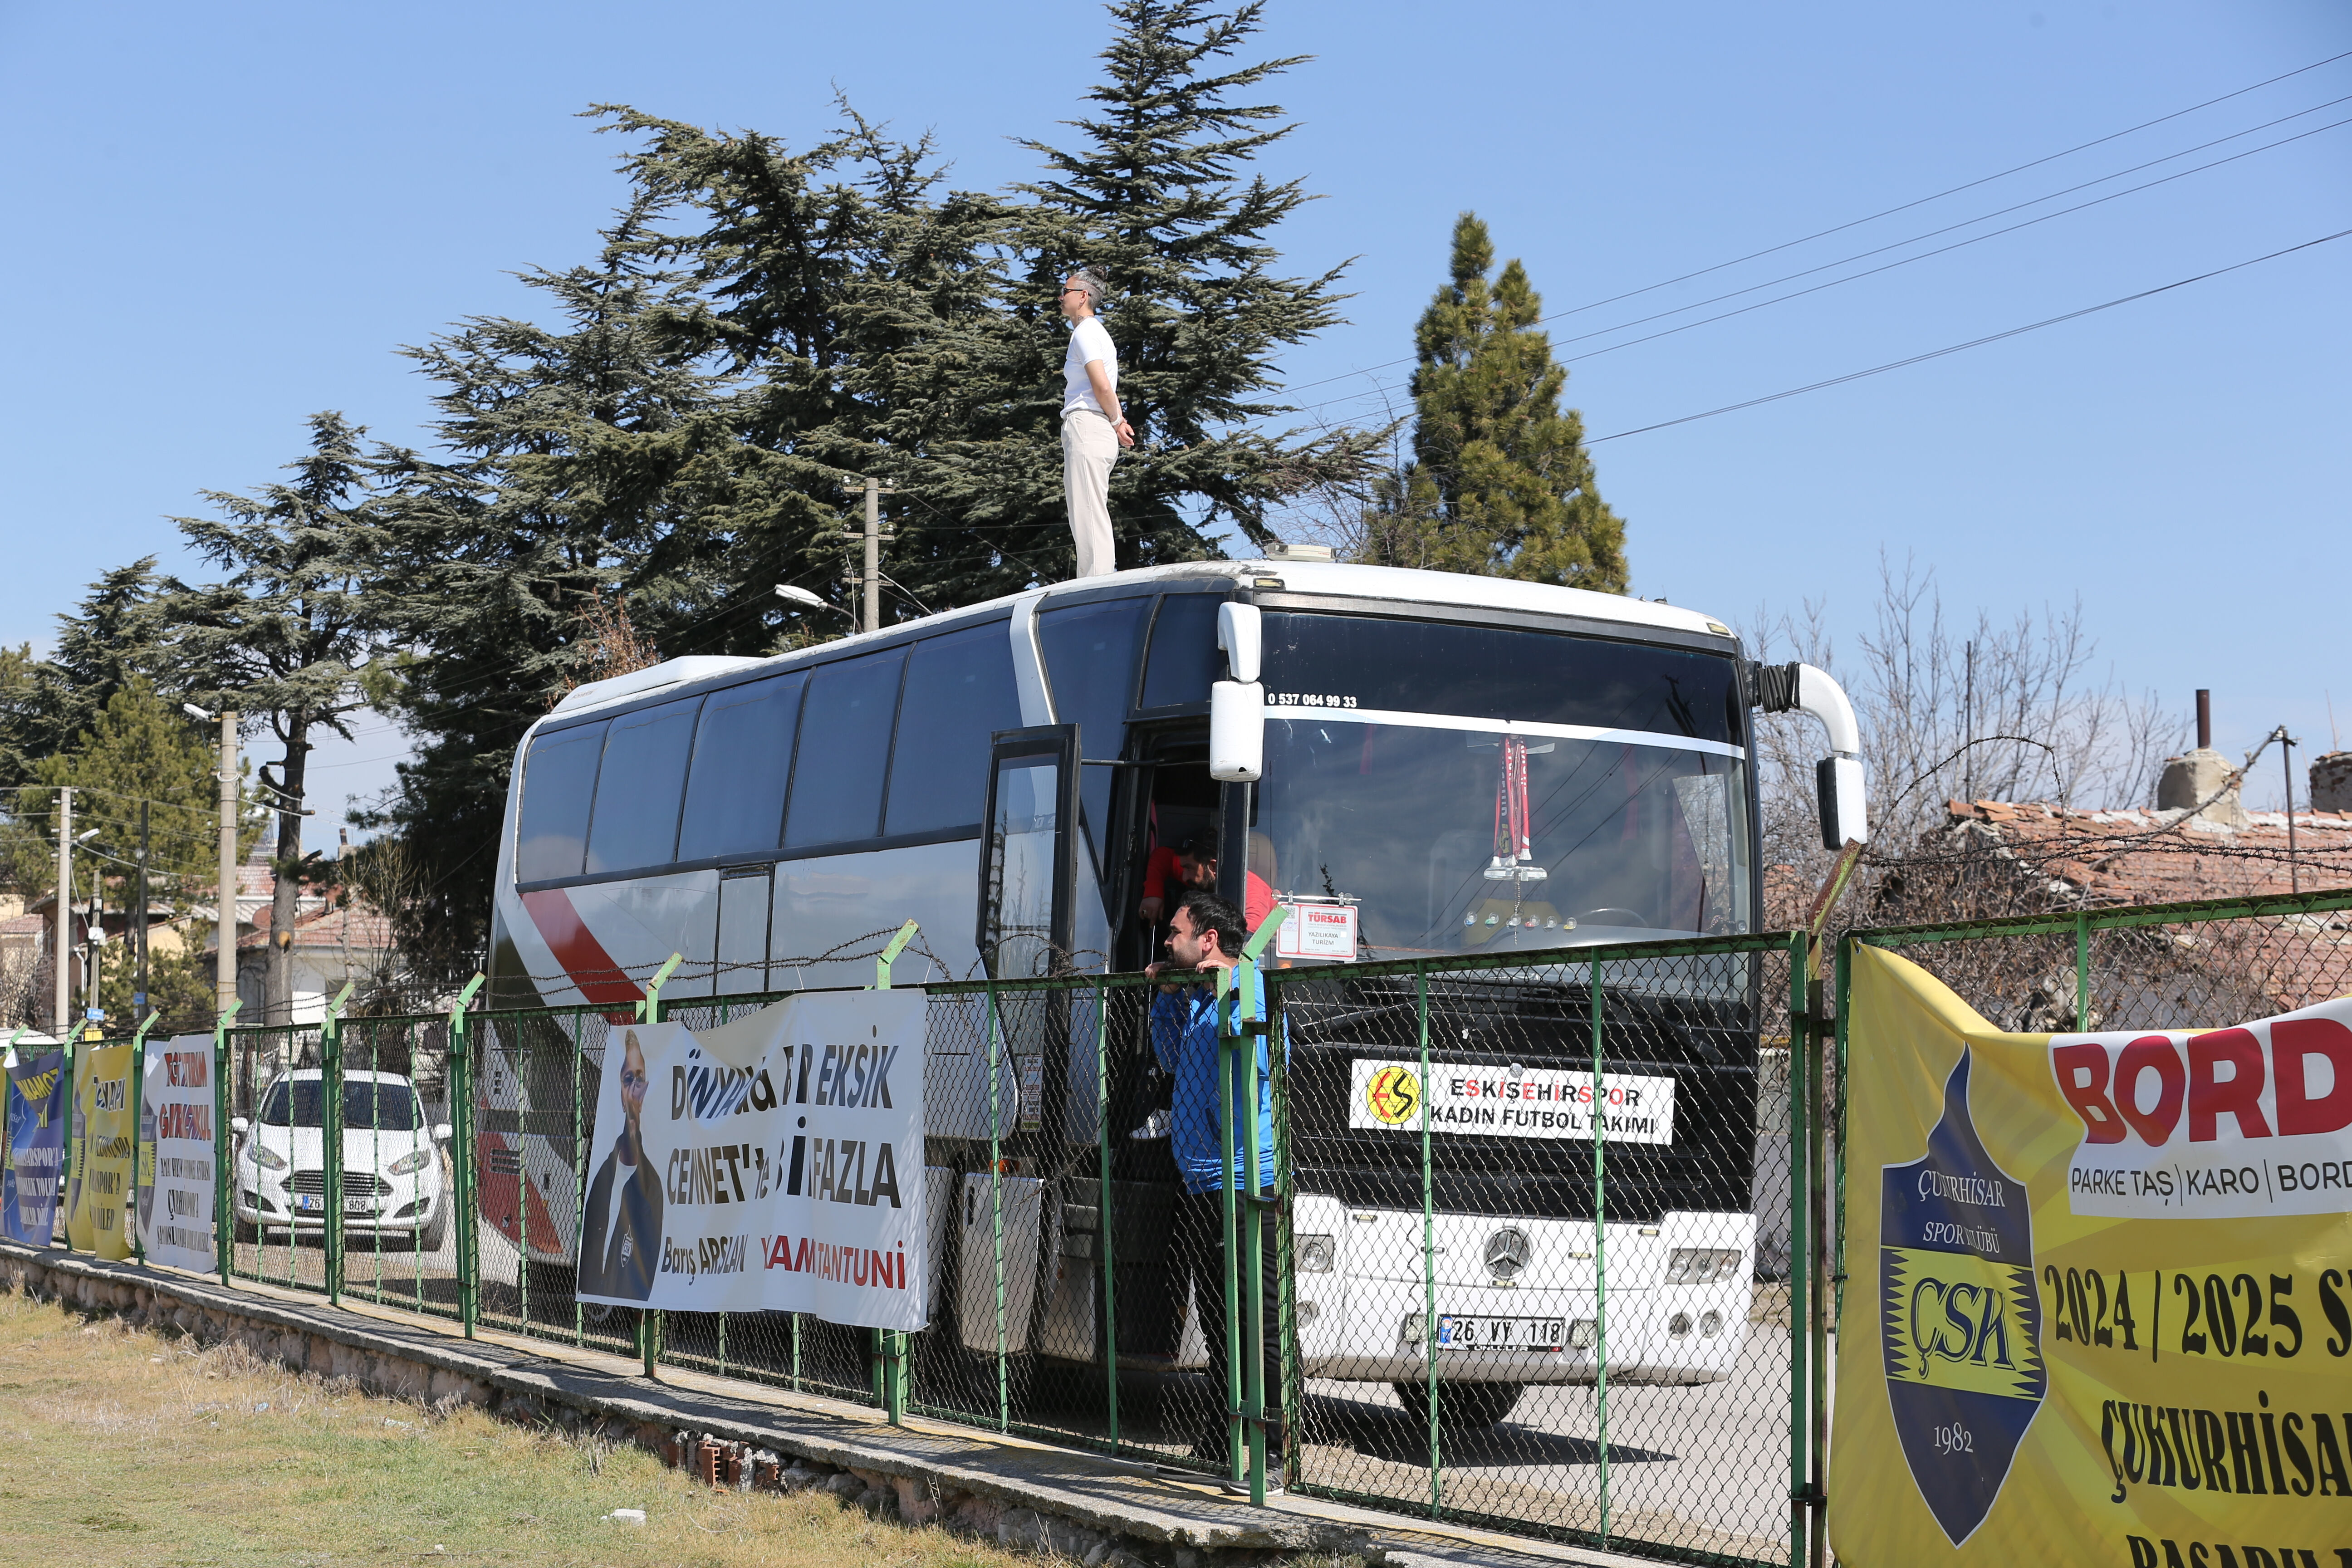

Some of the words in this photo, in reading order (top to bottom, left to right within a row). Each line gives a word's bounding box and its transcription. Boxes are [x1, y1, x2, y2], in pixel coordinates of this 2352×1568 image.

[1268, 693, 1275, 704] 0
[1279, 693, 1300, 705] 537
[1303, 694, 1323, 706] 064
[1326, 695, 1340, 706] 99
[1343, 696, 1357, 708] 33
[1308, 912, 1347, 924] TÜRSAB
[816, 1025, 899, 1109] EKSİK
[1450, 1077, 1640, 1107] ESKİŞEHİRSPOR
[1430, 1106, 1495, 1125] KADIN
[1503, 1109, 1581, 1130] FUTBOL
[1588, 1113, 1655, 1134] TAKIMI
[813, 1138, 902, 1208] FAZLA
[2072, 1168, 2126, 1196] PARKE
[2131, 1171, 2174, 1206] TAŞ
[2187, 1167, 2259, 1195] KARO
[309, 1198, 320, 1208] 26
[1923, 1221, 1965, 1244] SPOR
[661, 1237, 696, 1285] Barış
[699, 1234, 749, 1275] ARSLAN
[1910, 1277, 2016, 1380] ÇSK
[2318, 1269, 2352, 1357] S
[1453, 1321, 1474, 1341] 26
[1491, 1322, 1511, 1342] VY
[1531, 1322, 1561, 1343] 118
[1934, 1422, 1974, 1455] 1982
